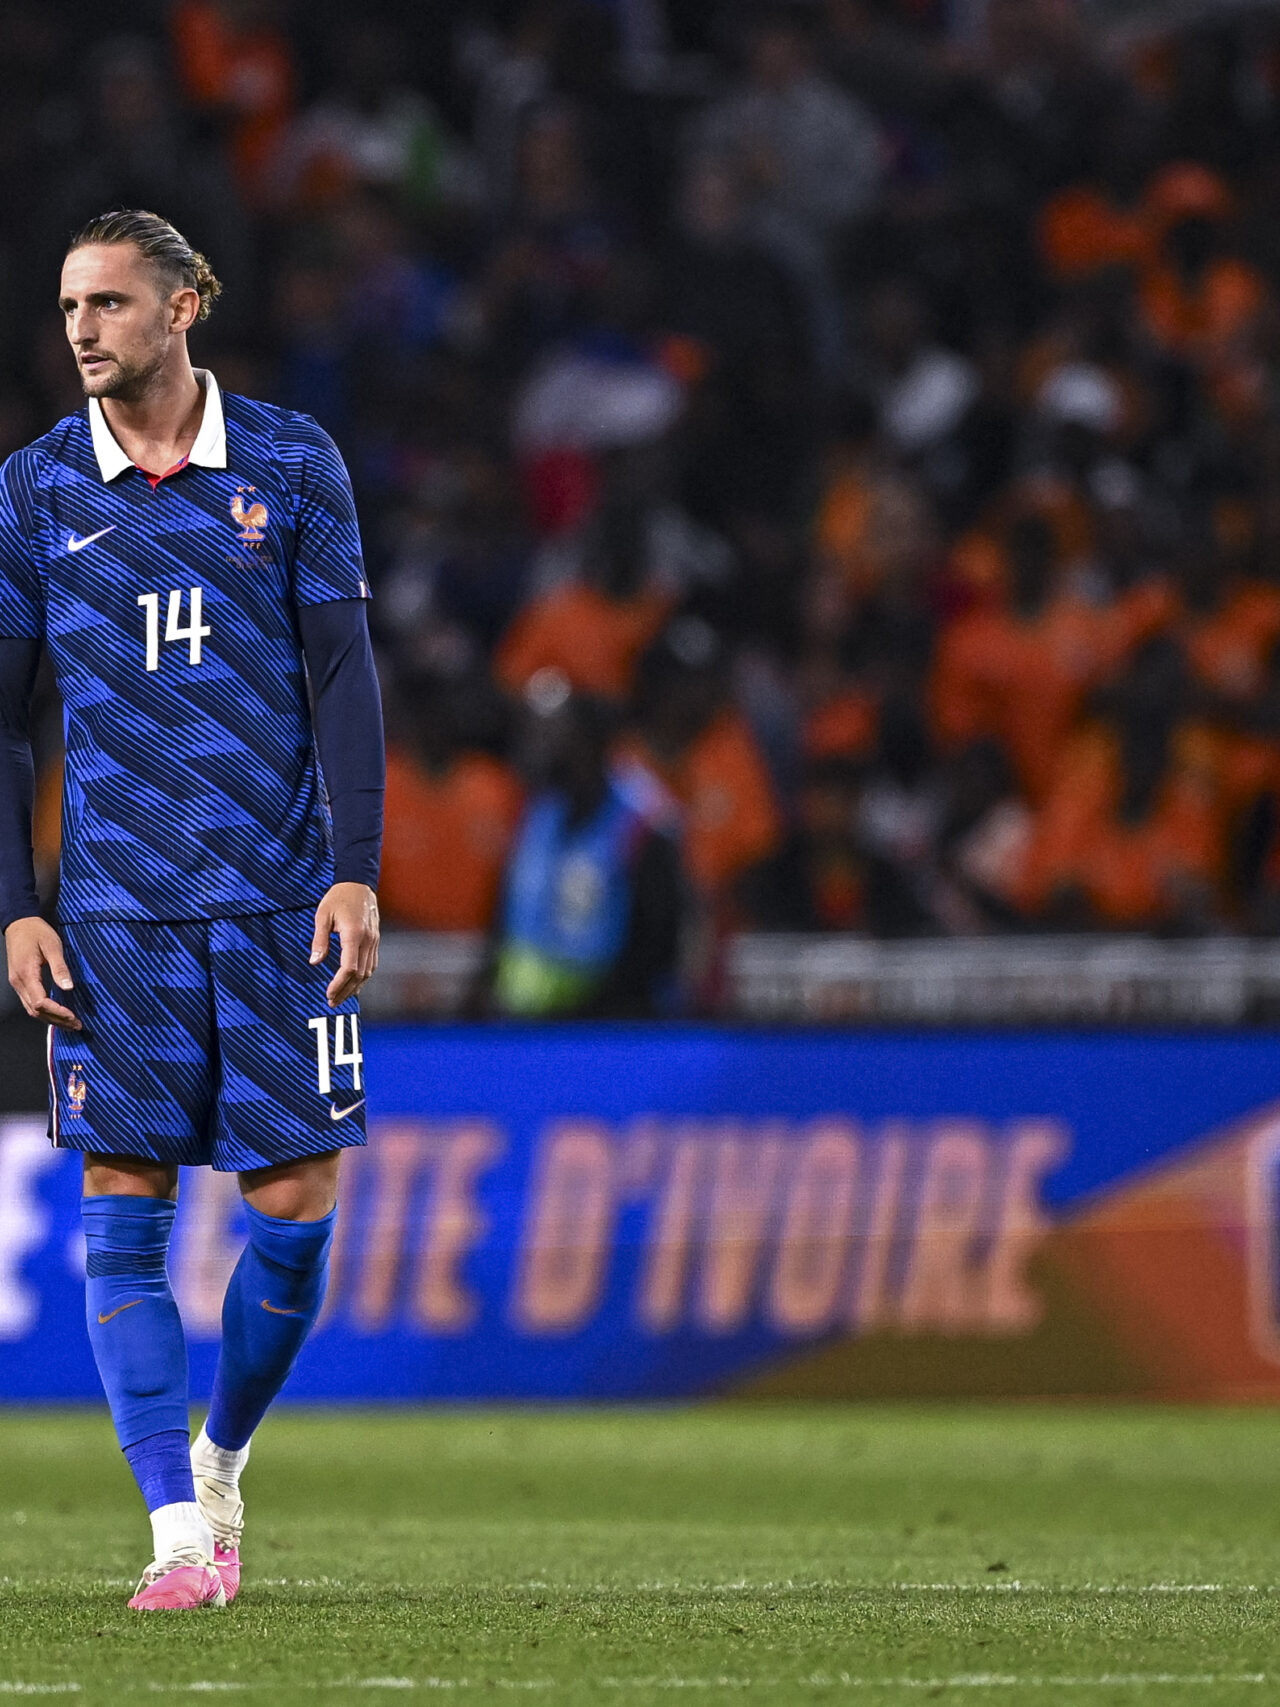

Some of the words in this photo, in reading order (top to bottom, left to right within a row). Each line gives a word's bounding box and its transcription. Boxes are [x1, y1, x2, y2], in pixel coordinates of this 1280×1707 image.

[137, 586, 211, 671] 14
[308, 1013, 363, 1094] 14
[510, 1118, 1073, 1336] D'IVOIRE
